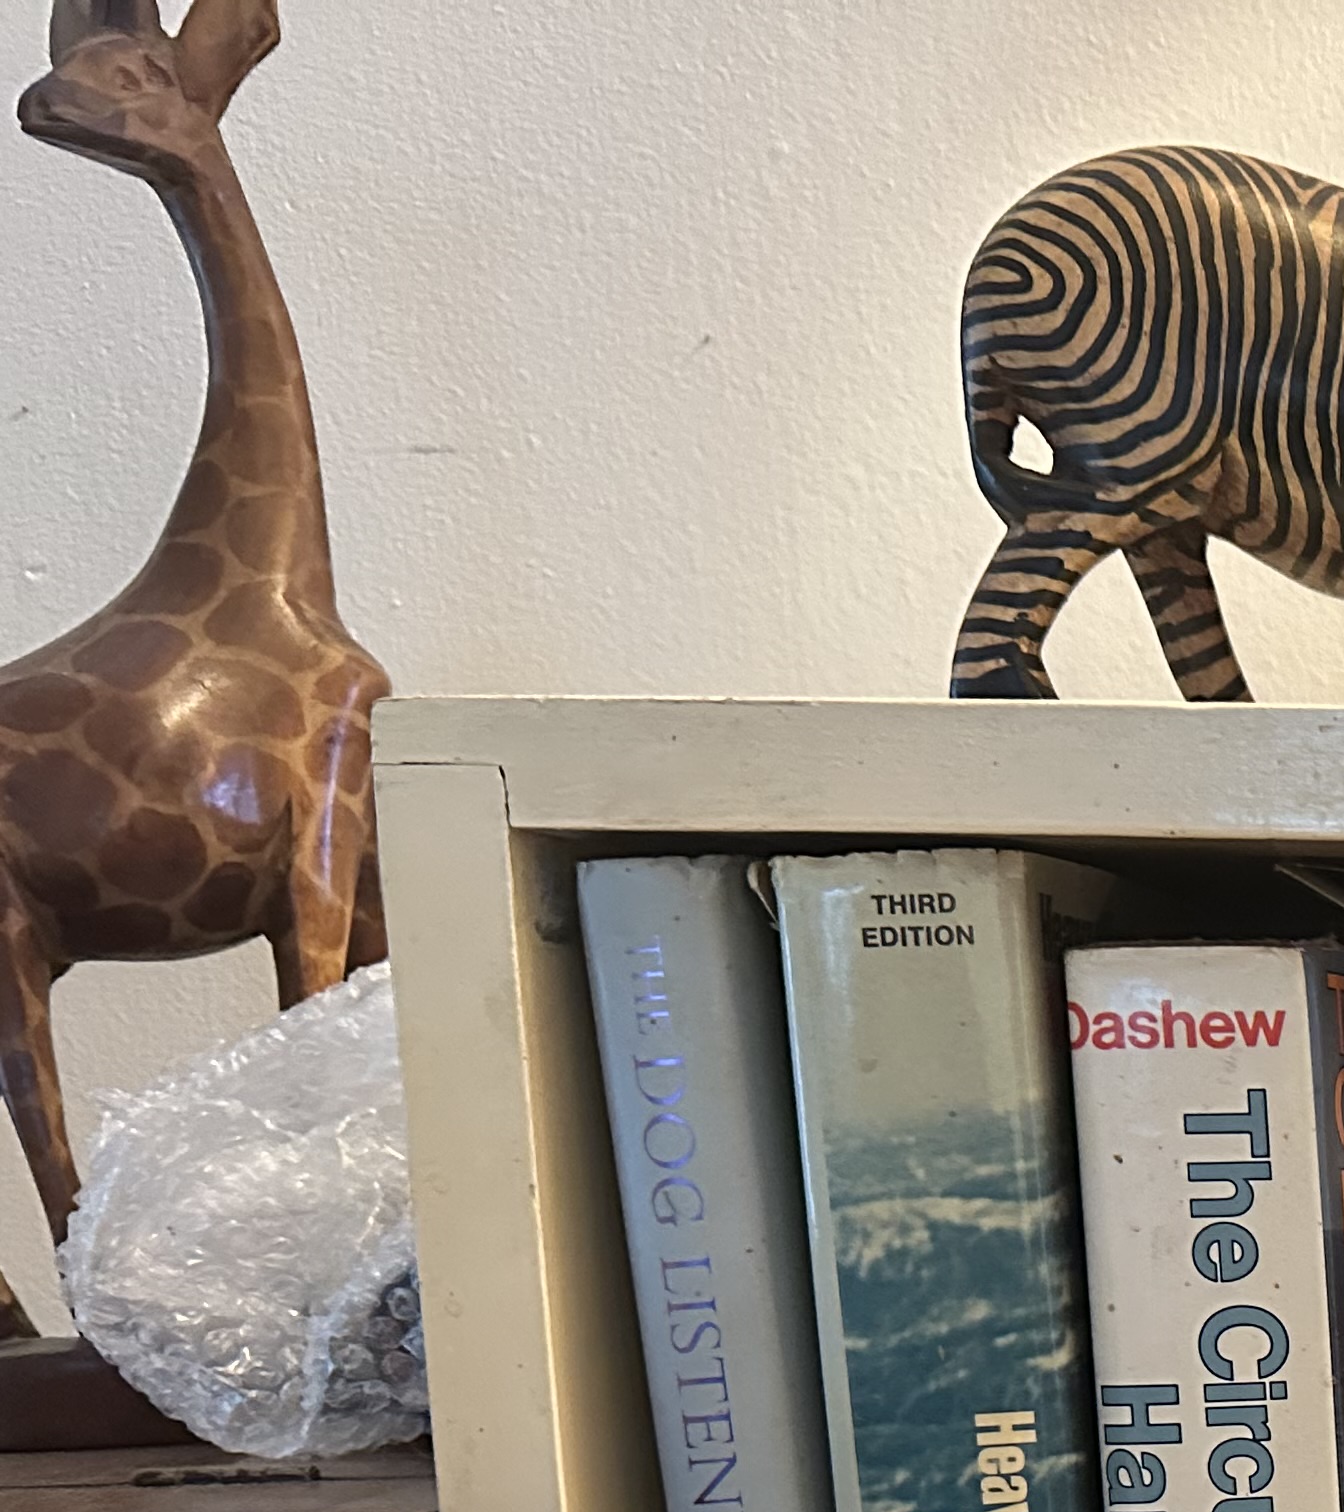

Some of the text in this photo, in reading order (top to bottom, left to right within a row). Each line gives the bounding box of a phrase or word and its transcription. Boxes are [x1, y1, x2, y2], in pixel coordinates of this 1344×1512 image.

[860, 923, 976, 949] EDITION
[869, 891, 957, 916] THIRD
[625, 934, 671, 1042] THE
[633, 1052, 706, 1231] DOG
[1183, 1087, 1273, 1284] The
